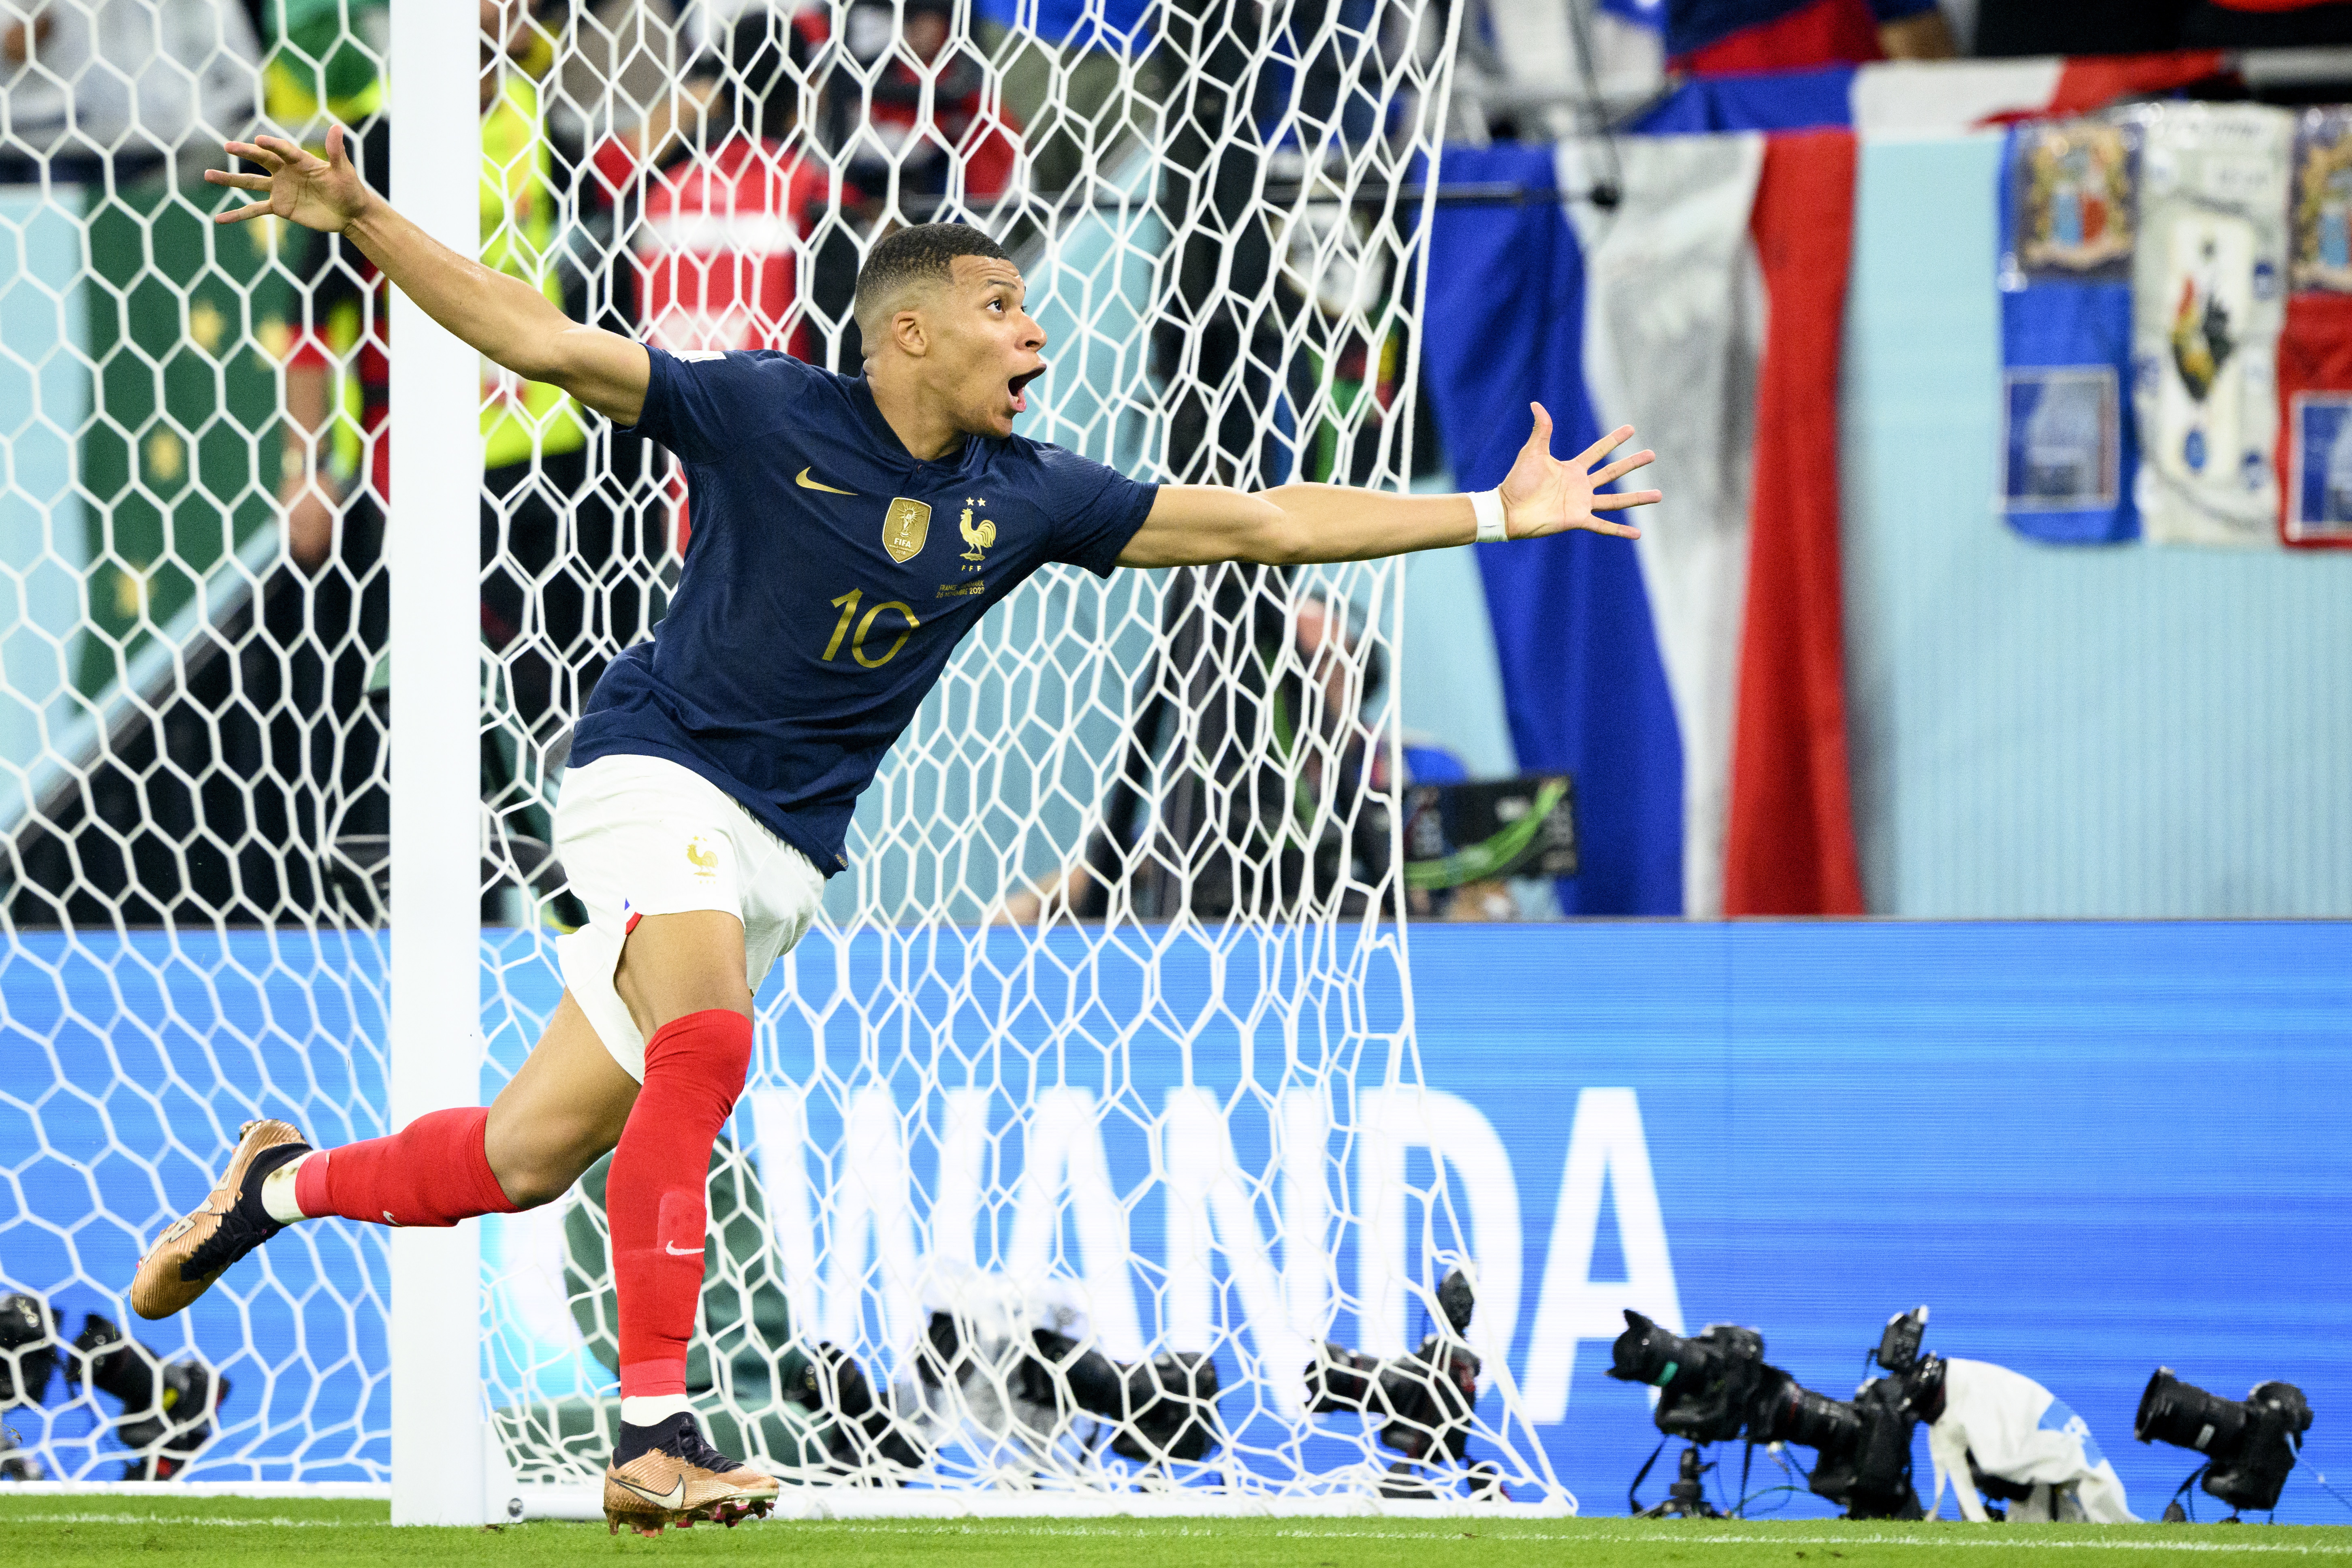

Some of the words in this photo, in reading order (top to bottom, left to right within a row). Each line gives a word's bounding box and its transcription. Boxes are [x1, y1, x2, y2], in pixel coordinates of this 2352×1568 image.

[894, 538, 911, 548] FIFA
[822, 588, 920, 668] 10
[751, 1087, 1688, 1424] WANDA
